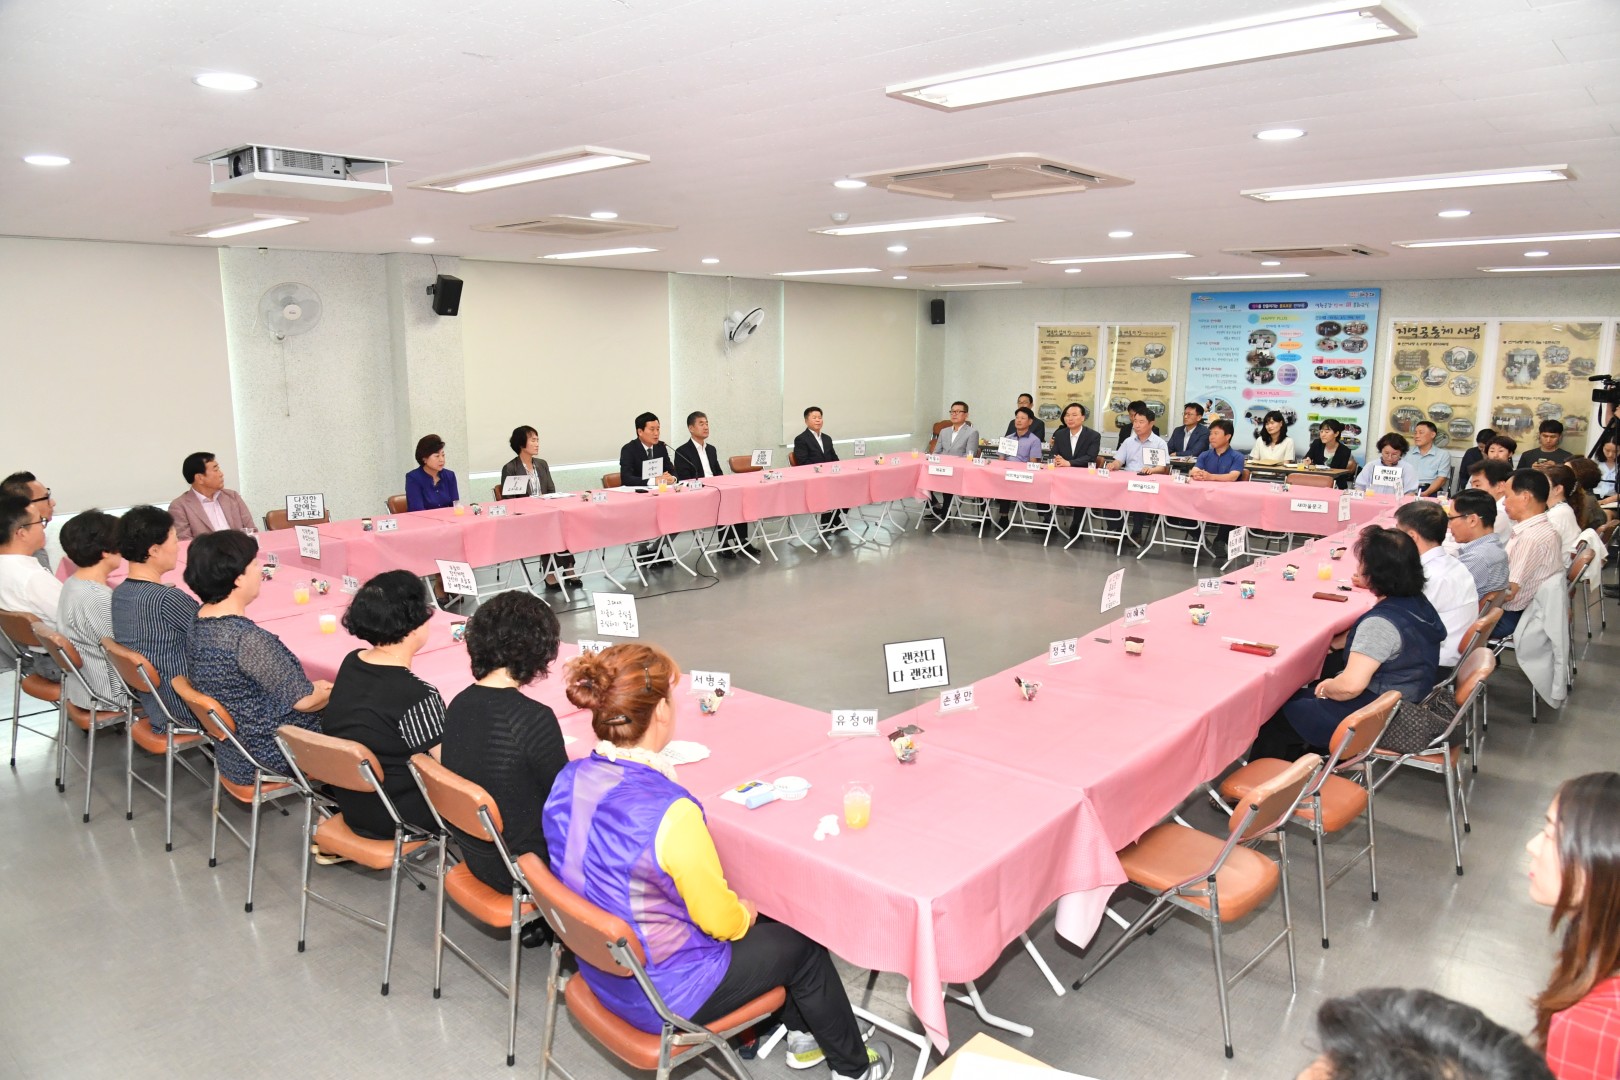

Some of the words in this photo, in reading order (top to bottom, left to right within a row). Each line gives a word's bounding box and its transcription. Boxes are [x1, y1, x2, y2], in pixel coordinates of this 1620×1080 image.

[1396, 326, 1453, 338] 지역공동체
[1458, 325, 1480, 339] 사업
[294, 495, 316, 504] 다정한
[901, 649, 935, 664] 괜찮다
[893, 670, 904, 682] 다
[910, 665, 943, 680] 괜찮다
[836, 714, 873, 727] 유정애
